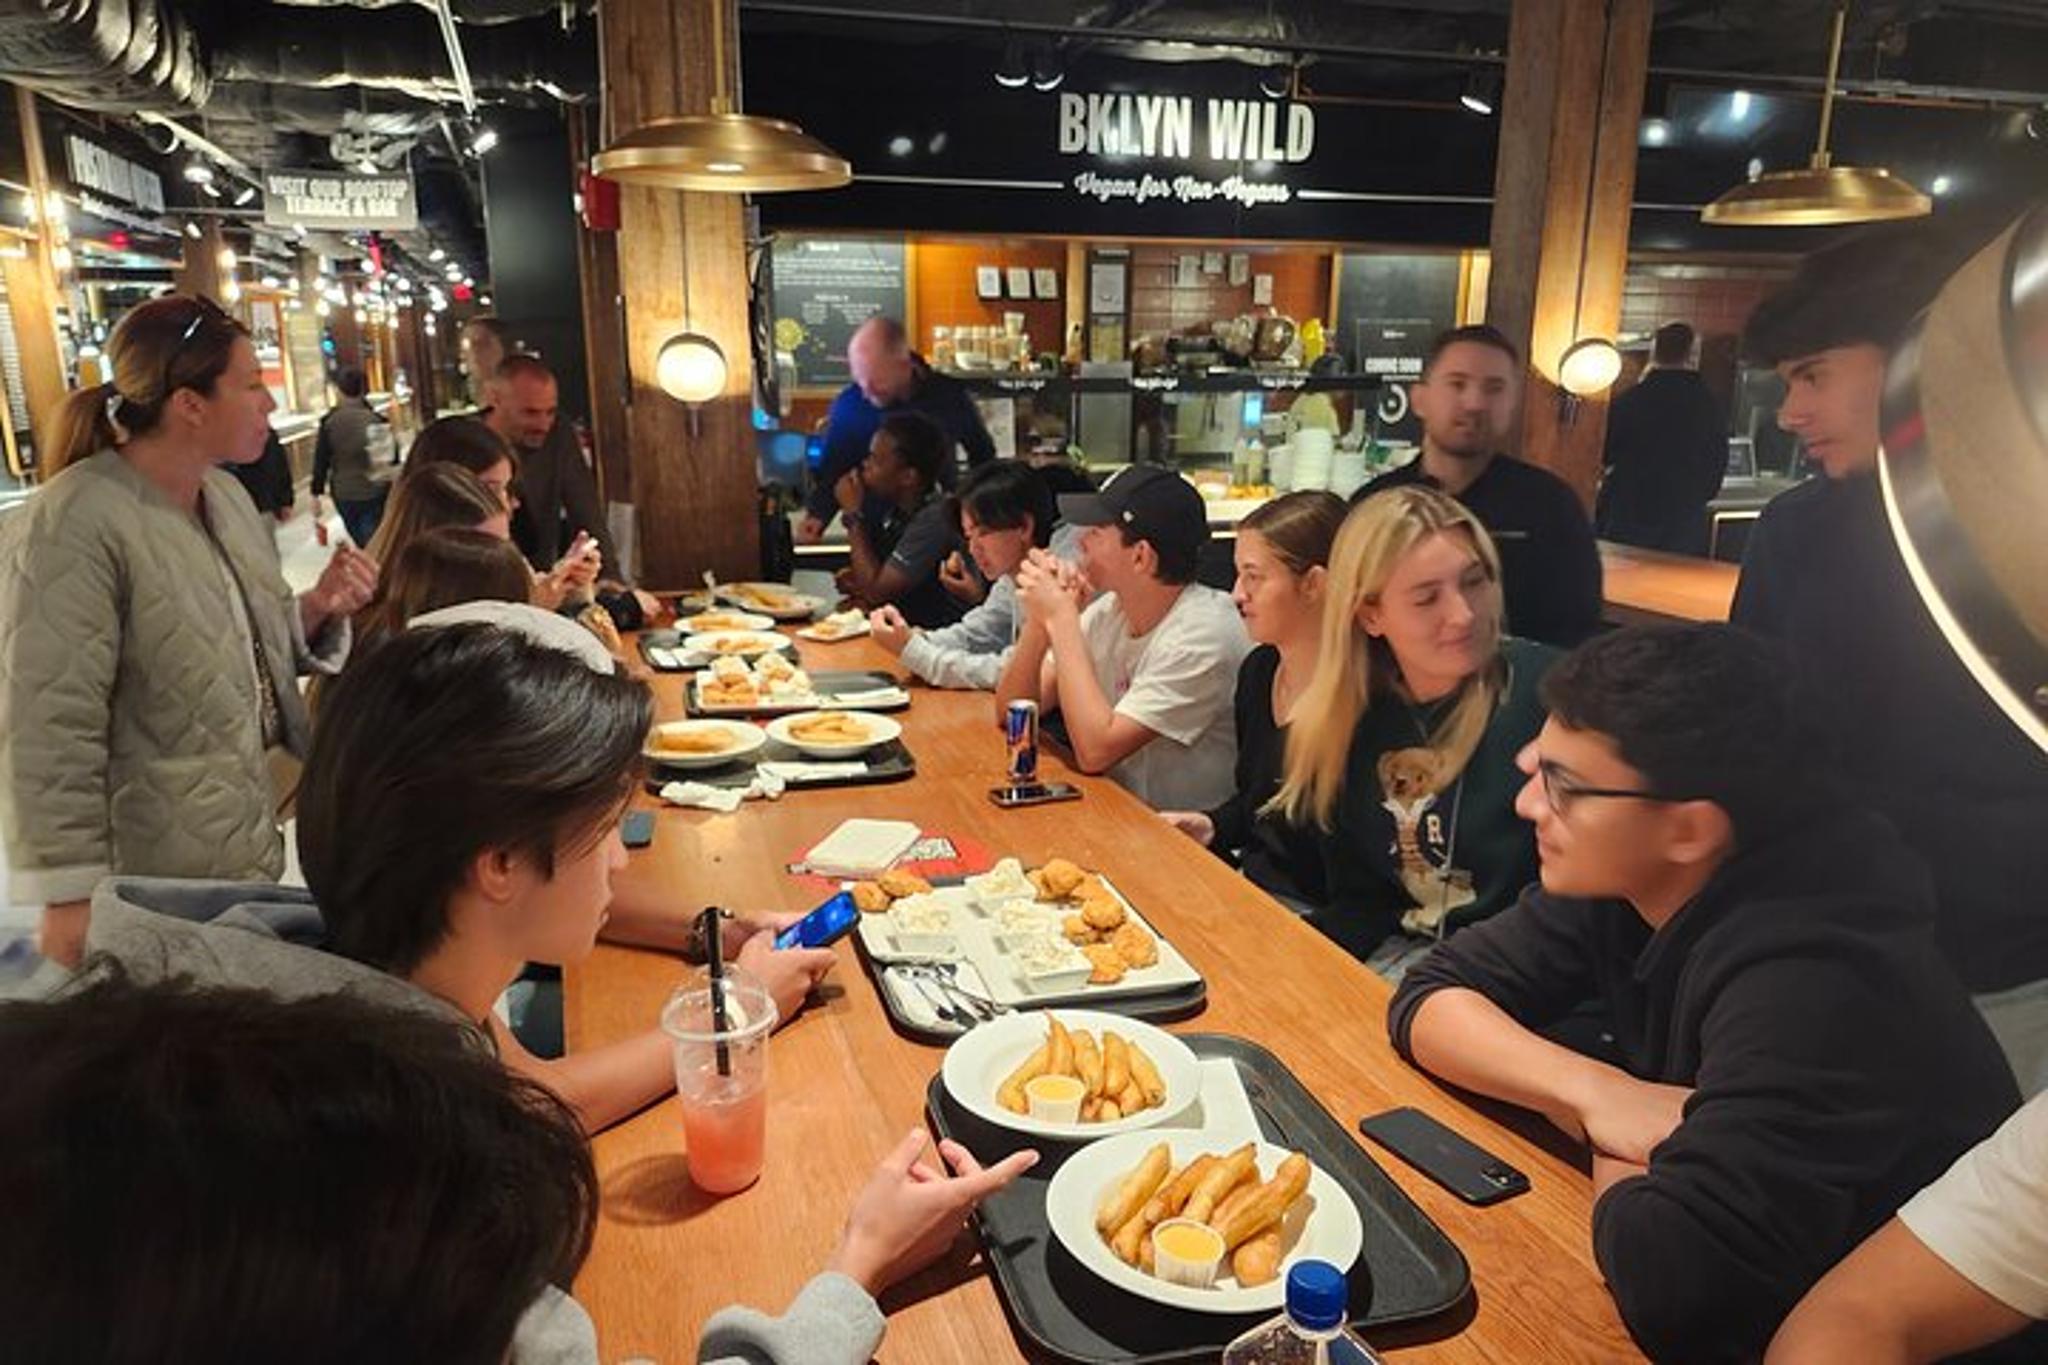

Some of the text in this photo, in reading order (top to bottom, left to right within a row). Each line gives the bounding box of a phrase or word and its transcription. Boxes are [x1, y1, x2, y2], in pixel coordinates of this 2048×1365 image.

[1059, 92, 1315, 163] BKLYN WILD
[268, 175, 408, 199] VISIT OUR ROOFTOP
[1074, 171, 1291, 208] Vegan for Non-Vegans
[285, 195, 351, 216] TERRACE
[368, 198, 400, 217] BAR
